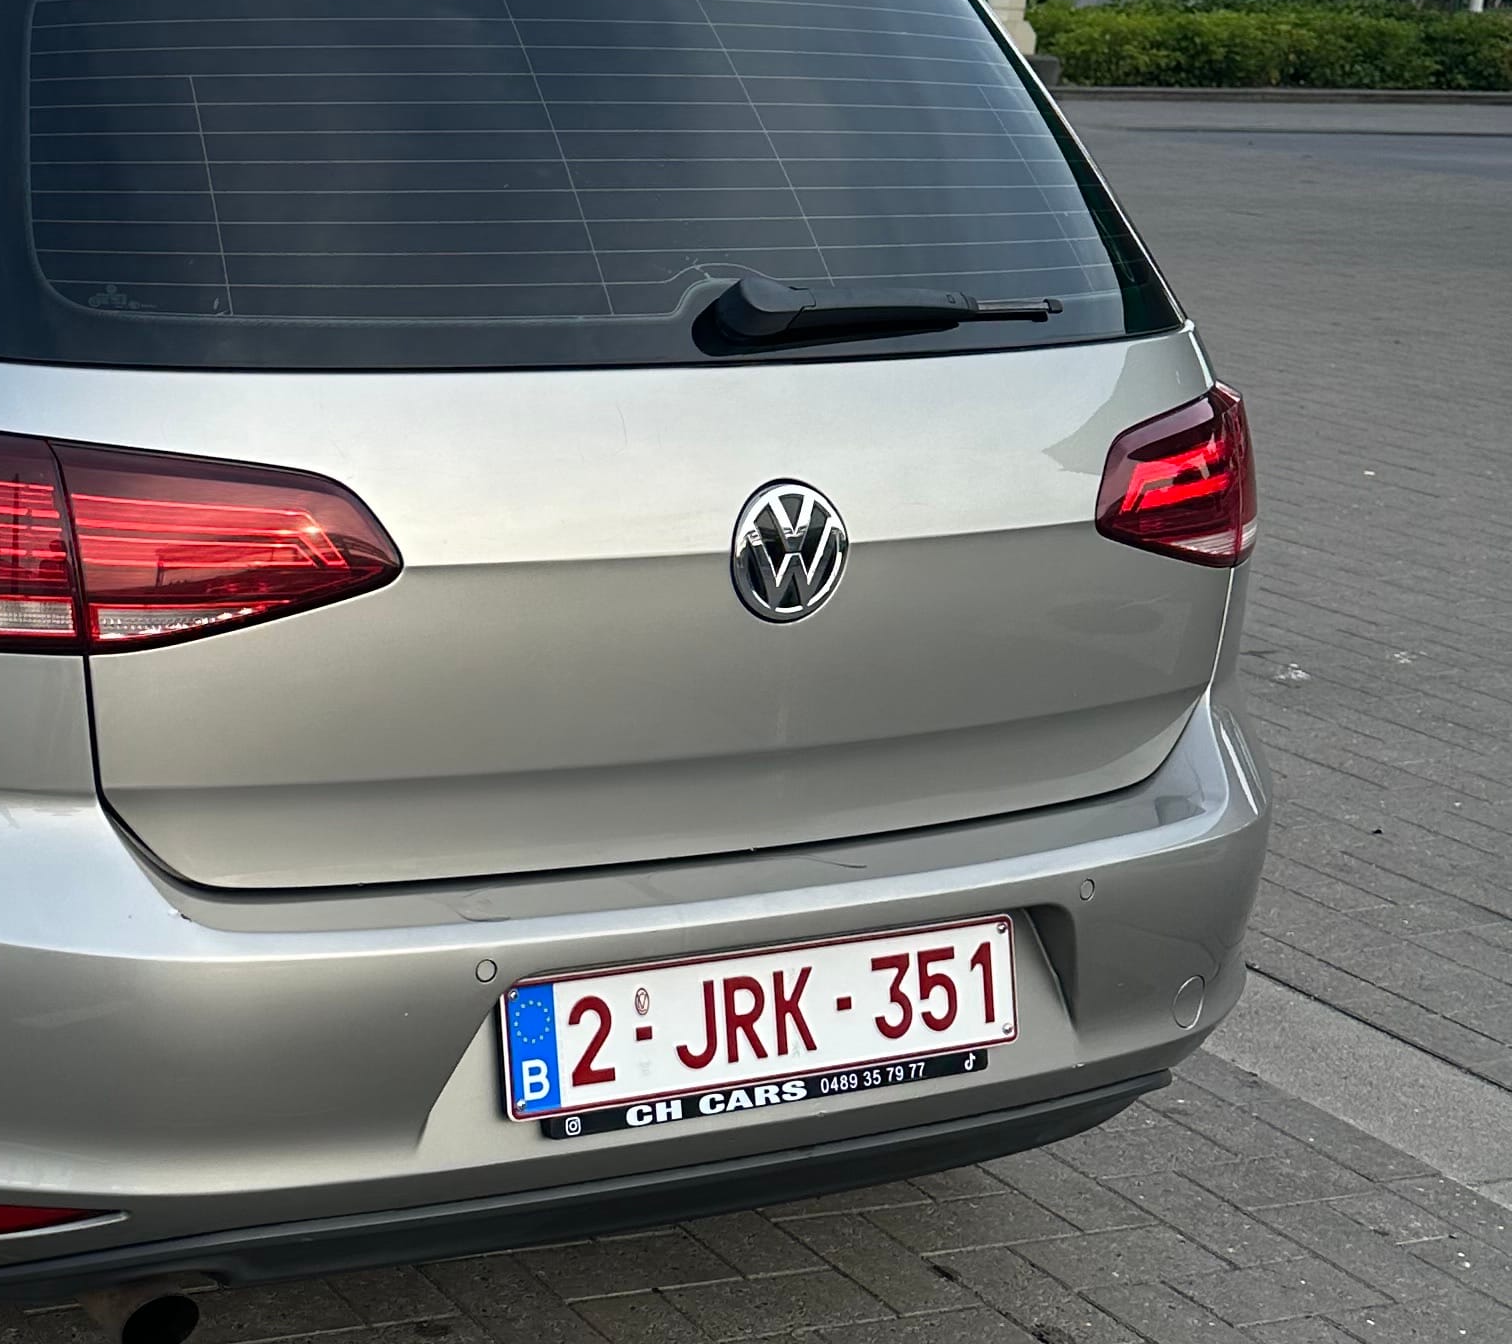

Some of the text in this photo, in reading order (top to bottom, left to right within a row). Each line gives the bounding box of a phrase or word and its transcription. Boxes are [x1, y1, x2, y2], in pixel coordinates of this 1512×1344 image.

[522, 1058, 550, 1101] B
[626, 1061, 926, 1127] CH CARS 0489 35 79 77
